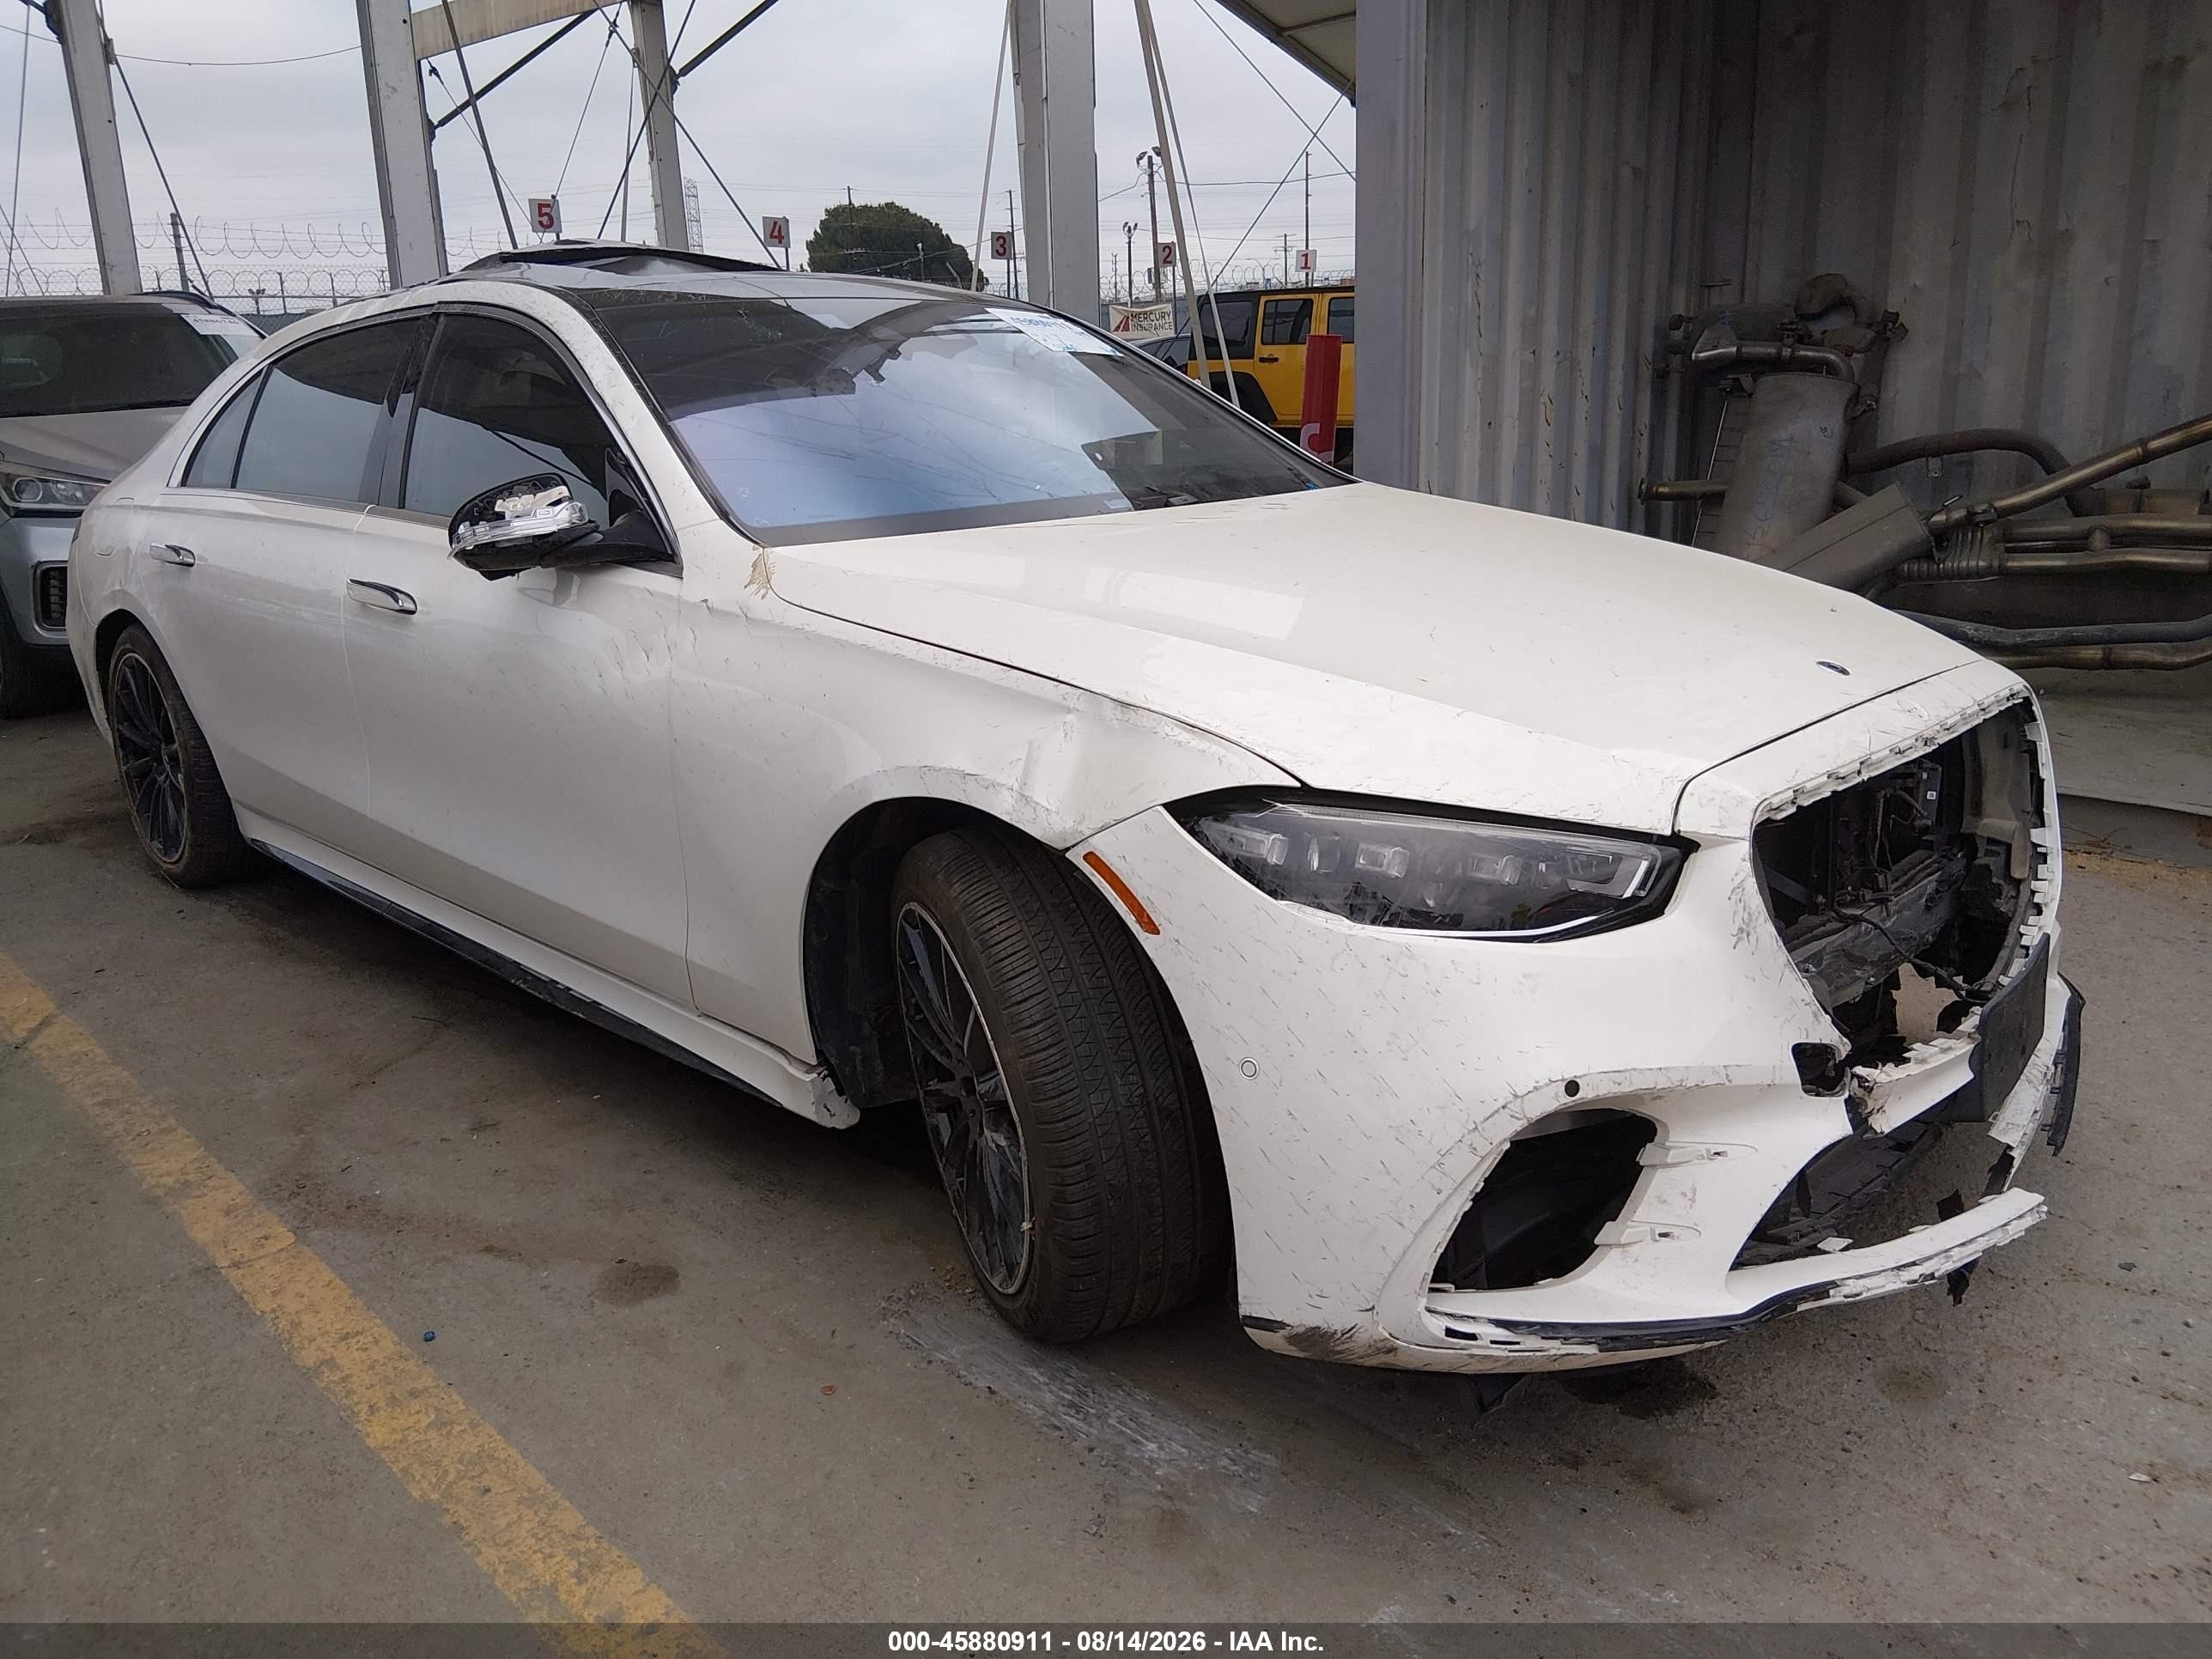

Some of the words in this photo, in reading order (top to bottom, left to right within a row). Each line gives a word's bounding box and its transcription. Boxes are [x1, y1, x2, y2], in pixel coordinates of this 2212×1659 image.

[538, 203, 554, 229] 5
[769, 221, 785, 244] 4
[996, 235, 1006, 257] 3
[1162, 245, 1173, 264] 2
[1300, 252, 1311, 270] 1
[1131, 310, 1171, 323] MERCURY
[1131, 321, 1173, 331] INSURANCE
